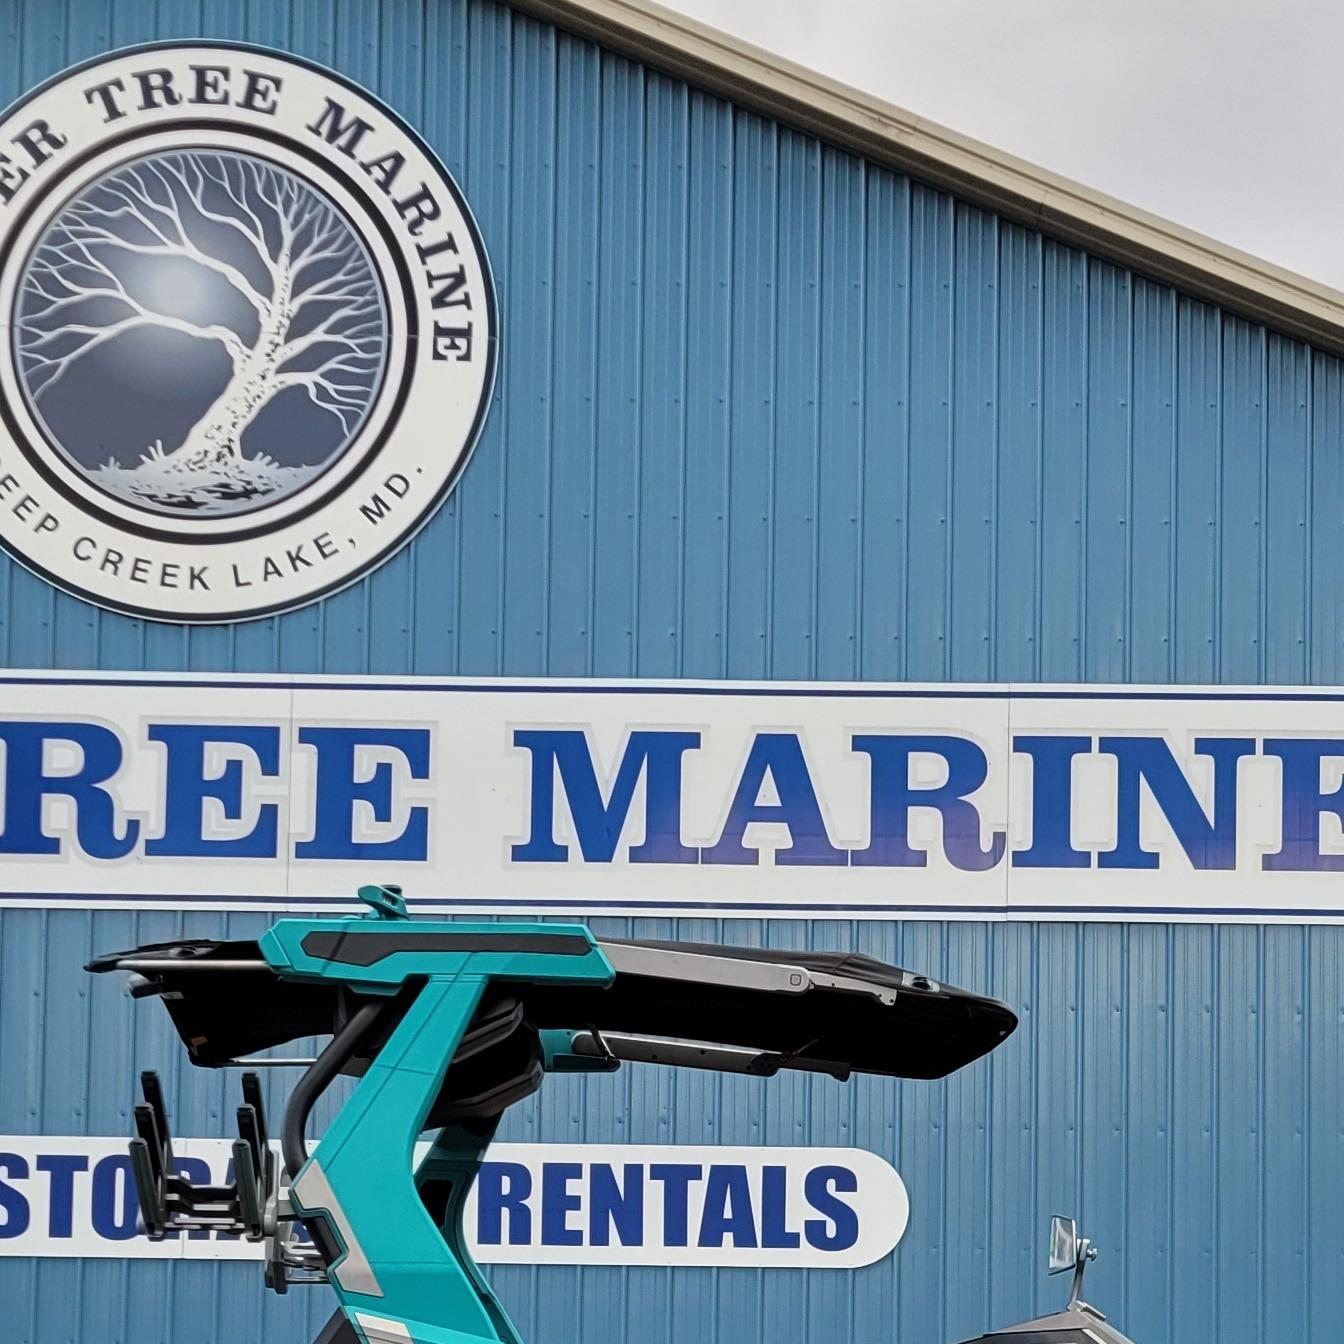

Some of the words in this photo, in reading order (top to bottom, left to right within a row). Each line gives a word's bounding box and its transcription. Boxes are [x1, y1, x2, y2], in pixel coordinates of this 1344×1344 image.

[84, 64, 284, 125] TREE
[305, 96, 473, 363] MARINE
[72, 536, 211, 591] CREEK
[232, 531, 357, 590] LAKE,
[358, 464, 424, 526] MD.
[475, 1162, 860, 1252] RENTALS
